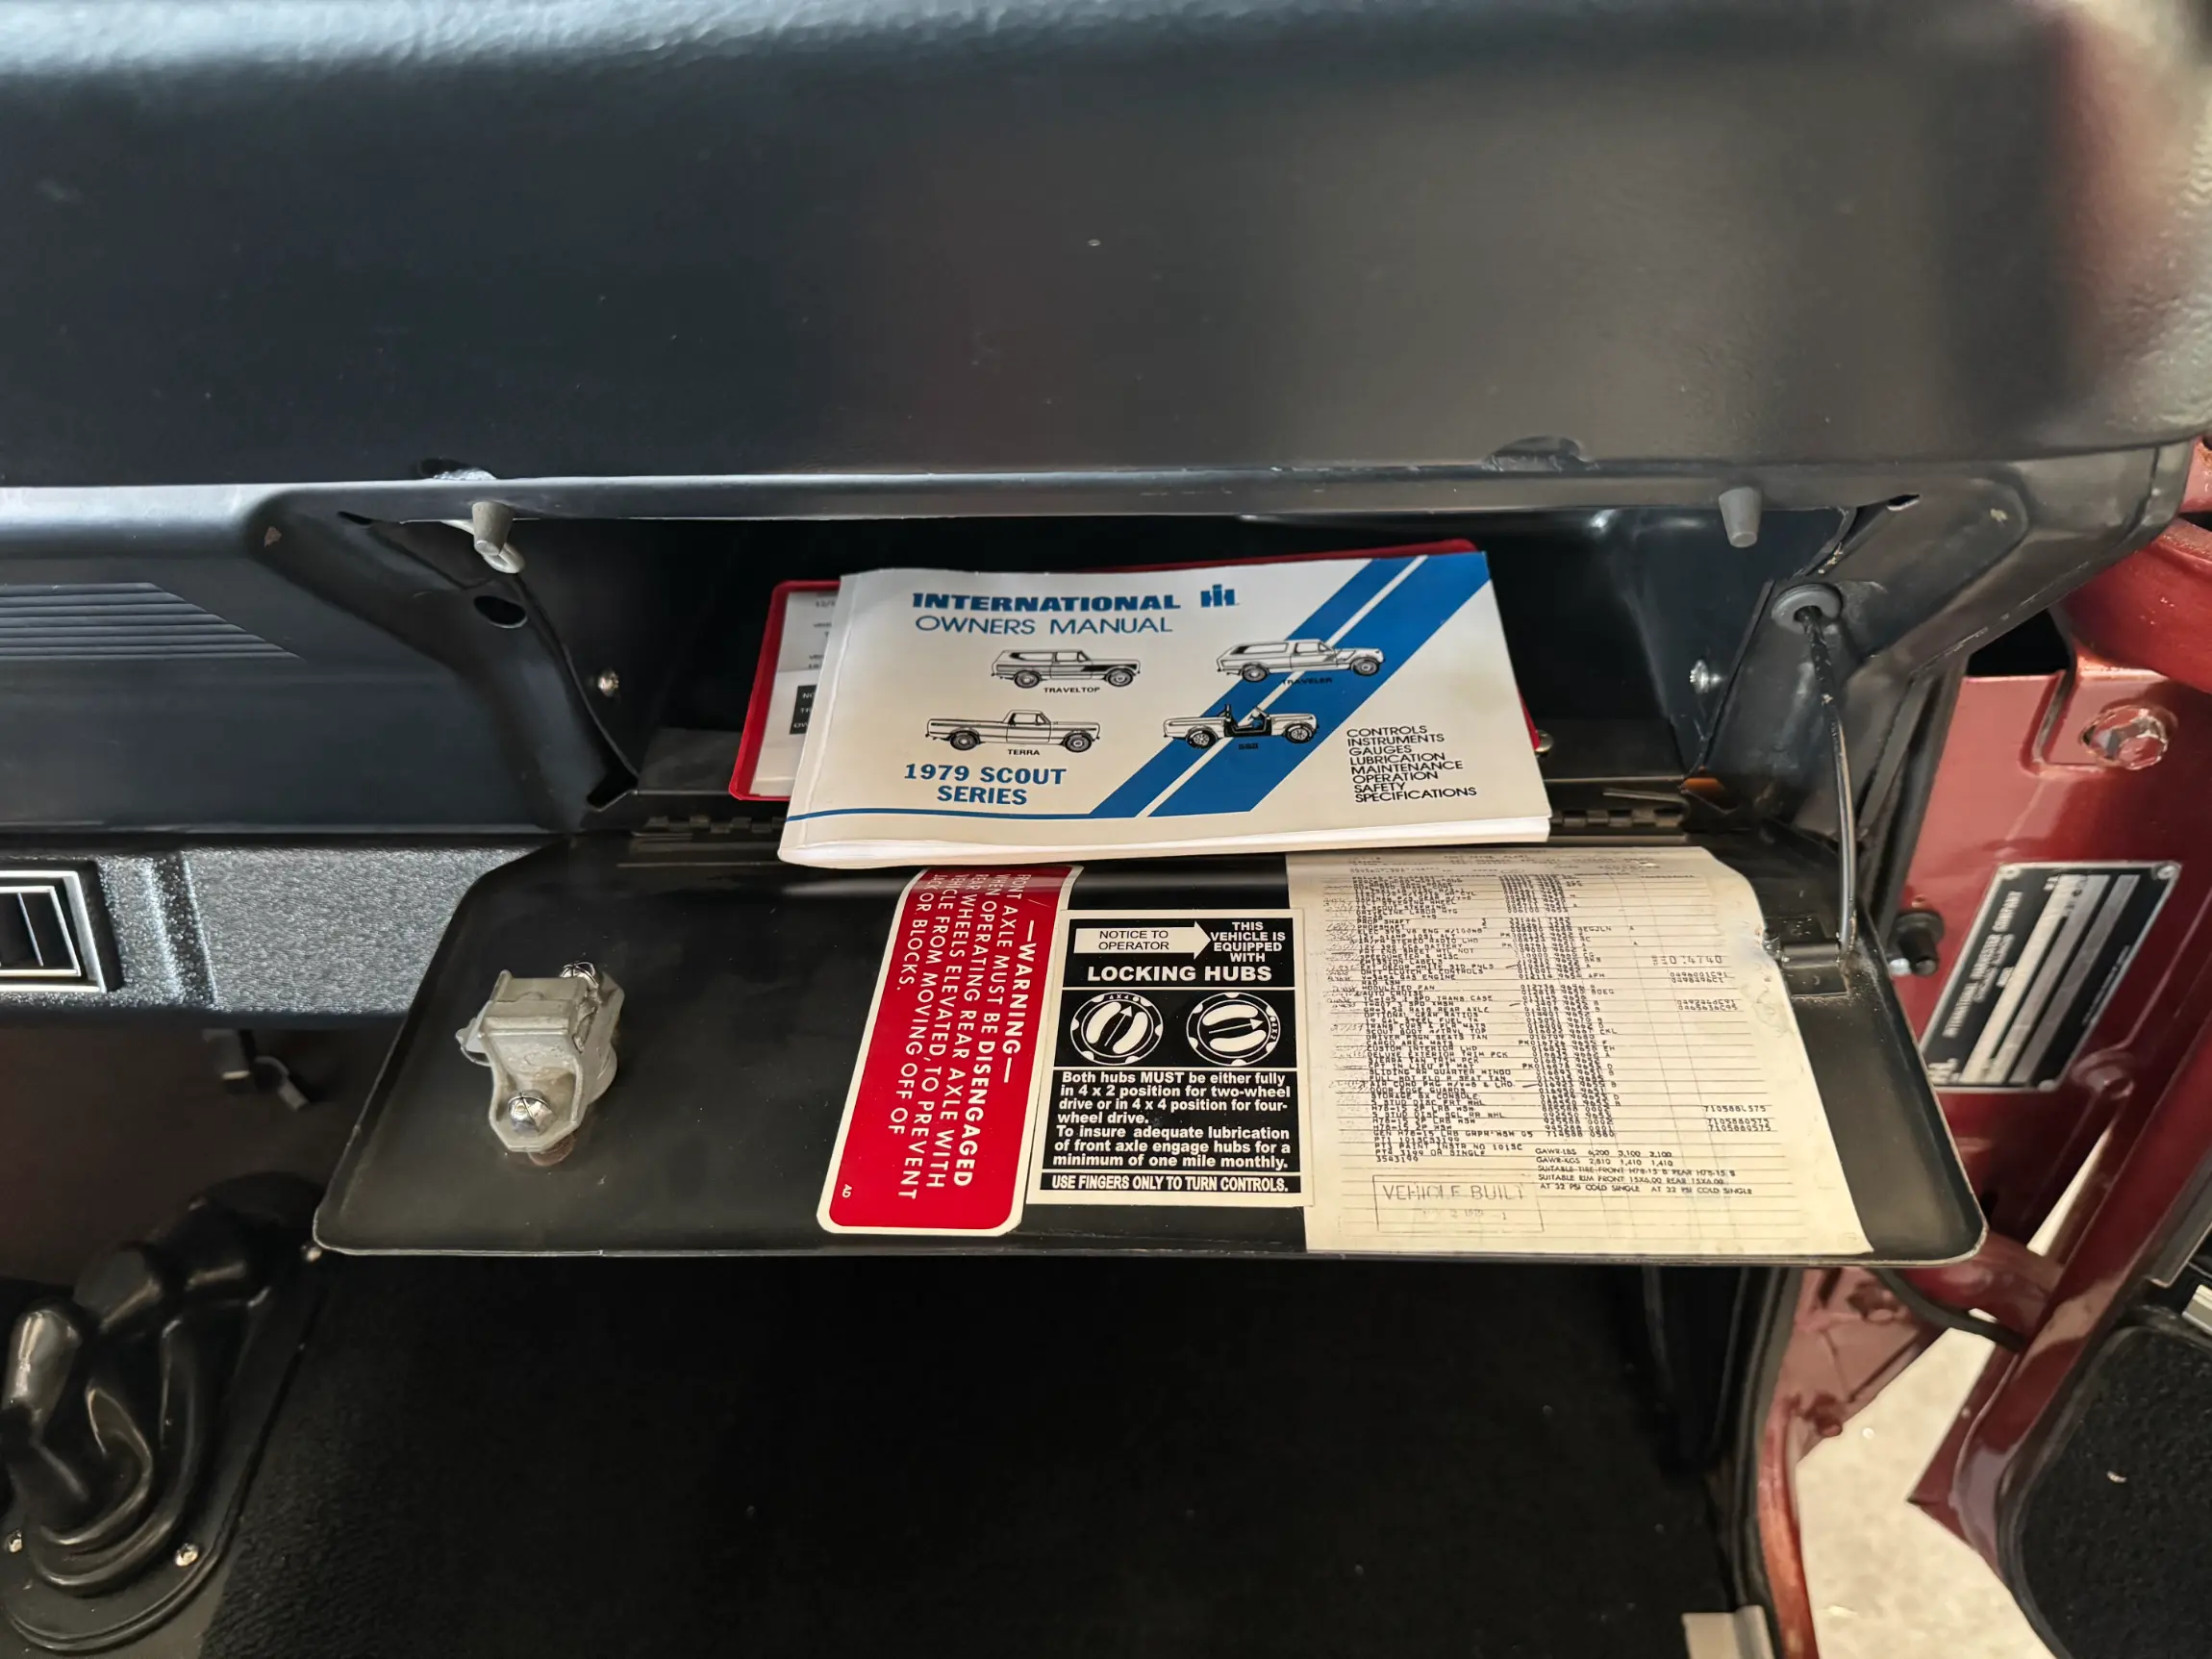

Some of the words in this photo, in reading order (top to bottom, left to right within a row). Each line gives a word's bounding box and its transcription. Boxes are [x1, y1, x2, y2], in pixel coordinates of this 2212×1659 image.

[912, 592, 1181, 613] INTERNATIONAL
[916, 616, 1036, 635] OWNERS
[1050, 617, 1172, 635] MANUAL
[1346, 725, 1427, 738] CONTROLS
[1347, 734, 1445, 746] INSTRUMENTS
[1349, 744, 1412, 756] GAUGES
[1350, 752, 1445, 766] LUBRICATION
[904, 764, 969, 781] 1979
[980, 767, 1067, 785] SCOUT
[1351, 760, 1463, 774] MAINTENANCE
[1353, 771, 1438, 784] OPERATION
[937, 785, 1027, 805] SERIES
[1354, 782, 1405, 793] SAFETY
[1355, 787, 1477, 803] SPECIFICATIONS
[924, 873, 949, 890] JACK
[966, 873, 990, 891] REAR
[985, 873, 1011, 895] WHEN
[1007, 874, 1032, 899] FRONT
[938, 873, 969, 910] VEHICLE
[916, 892, 934, 912] OR
[949, 893, 977, 957] WHEELS
[996, 905, 1018, 947] AXLE
[1232, 921, 1264, 931] THIS
[925, 917, 950, 964] FROM
[1099, 930, 1147, 939] NOTICE
[1151, 930, 1169, 939] TO
[1210, 932, 1269, 942] VEHICLE
[1272, 931, 1286, 941] IS
[896, 919, 928, 991] BLOCKS.
[964, 900, 997, 1001] OPERATING
[1098, 942, 1169, 950] OPERATOR
[1214, 942, 1282, 952] EQUIPPED
[1230, 952, 1266, 962] WITH
[987, 955, 1010, 1004] MUST
[1088, 966, 1195, 982] LOCKING
[1204, 966, 1272, 982] HUBS
[906, 972, 939, 1055] MOVING
[923, 966, 962, 1061] ELEVATED,
[981, 1012, 1000, 1034] BE
[952, 1010, 977, 1058] REAR
[896, 1063, 917, 1099] OFF
[921, 1067, 942, 1092] TO
[1062, 1071, 1096, 1083] Both
[1101, 1071, 1136, 1083] hubs
[1141, 1072, 1184, 1083] MUST
[1189, 1072, 1205, 1084] be
[1210, 1072, 1251, 1084] either
[1255, 1072, 1285, 1086] fully
[940, 1068, 966, 1120] AXLE
[1061, 1085, 1073, 1096] in
[1078, 1085, 1088, 1096] 4
[1093, 1088, 1101, 1096] x
[1106, 1085, 1115, 1096] 2
[1119, 1085, 1180, 1099] position
[1185, 1085, 1207, 1096] for
[1211, 1086, 1291, 1098] two-wheel
[954, 1041, 995, 1187] DISENGAGED
[1059, 1098, 1093, 1110] drive
[1096, 1101, 1112, 1110] or
[1116, 1098, 1128, 1110] in
[1132, 1098, 1141, 1110] 4
[1144, 1101, 1153, 1110] x
[1157, 1098, 1167, 1110] 4
[1170, 1098, 1226, 1113] position
[1231, 1098, 1250, 1111] for
[1254, 1099, 1288, 1111] four-
[889, 1108, 908, 1135] OF
[1057, 1112, 1102, 1123] wheel
[1107, 1112, 1149, 1124] drive.
[1056, 1125, 1073, 1137] To
[1079, 1125, 1126, 1138] insure
[1133, 1126, 1203, 1141] adequate
[1208, 1126, 1290, 1139] lubrication
[898, 1101, 935, 1199] PREVENT
[1055, 1140, 1071, 1151] of
[1074, 1140, 1111, 1151] front
[1115, 1141, 1147, 1152] axle
[1153, 1143, 1209, 1155] engage
[1214, 1141, 1250, 1153] hubs
[1255, 1142, 1276, 1153] for
[1281, 1144, 1291, 1153] a
[926, 1129, 955, 1187] WITH
[1053, 1154, 1123, 1166] minimum
[1128, 1155, 1144, 1166] of
[1149, 1157, 1178, 1167] one
[1182, 1155, 1216, 1167] mile
[1220, 1156, 1289, 1170] monthly.
[1052, 1175, 1075, 1189] USE
[1078, 1175, 1129, 1190] FINGERS
[1133, 1175, 1164, 1190] ONLY
[1167, 1176, 1182, 1190] TO
[1185, 1176, 1217, 1191] TURN
[1220, 1176, 1289, 1192] CONTROLS.
